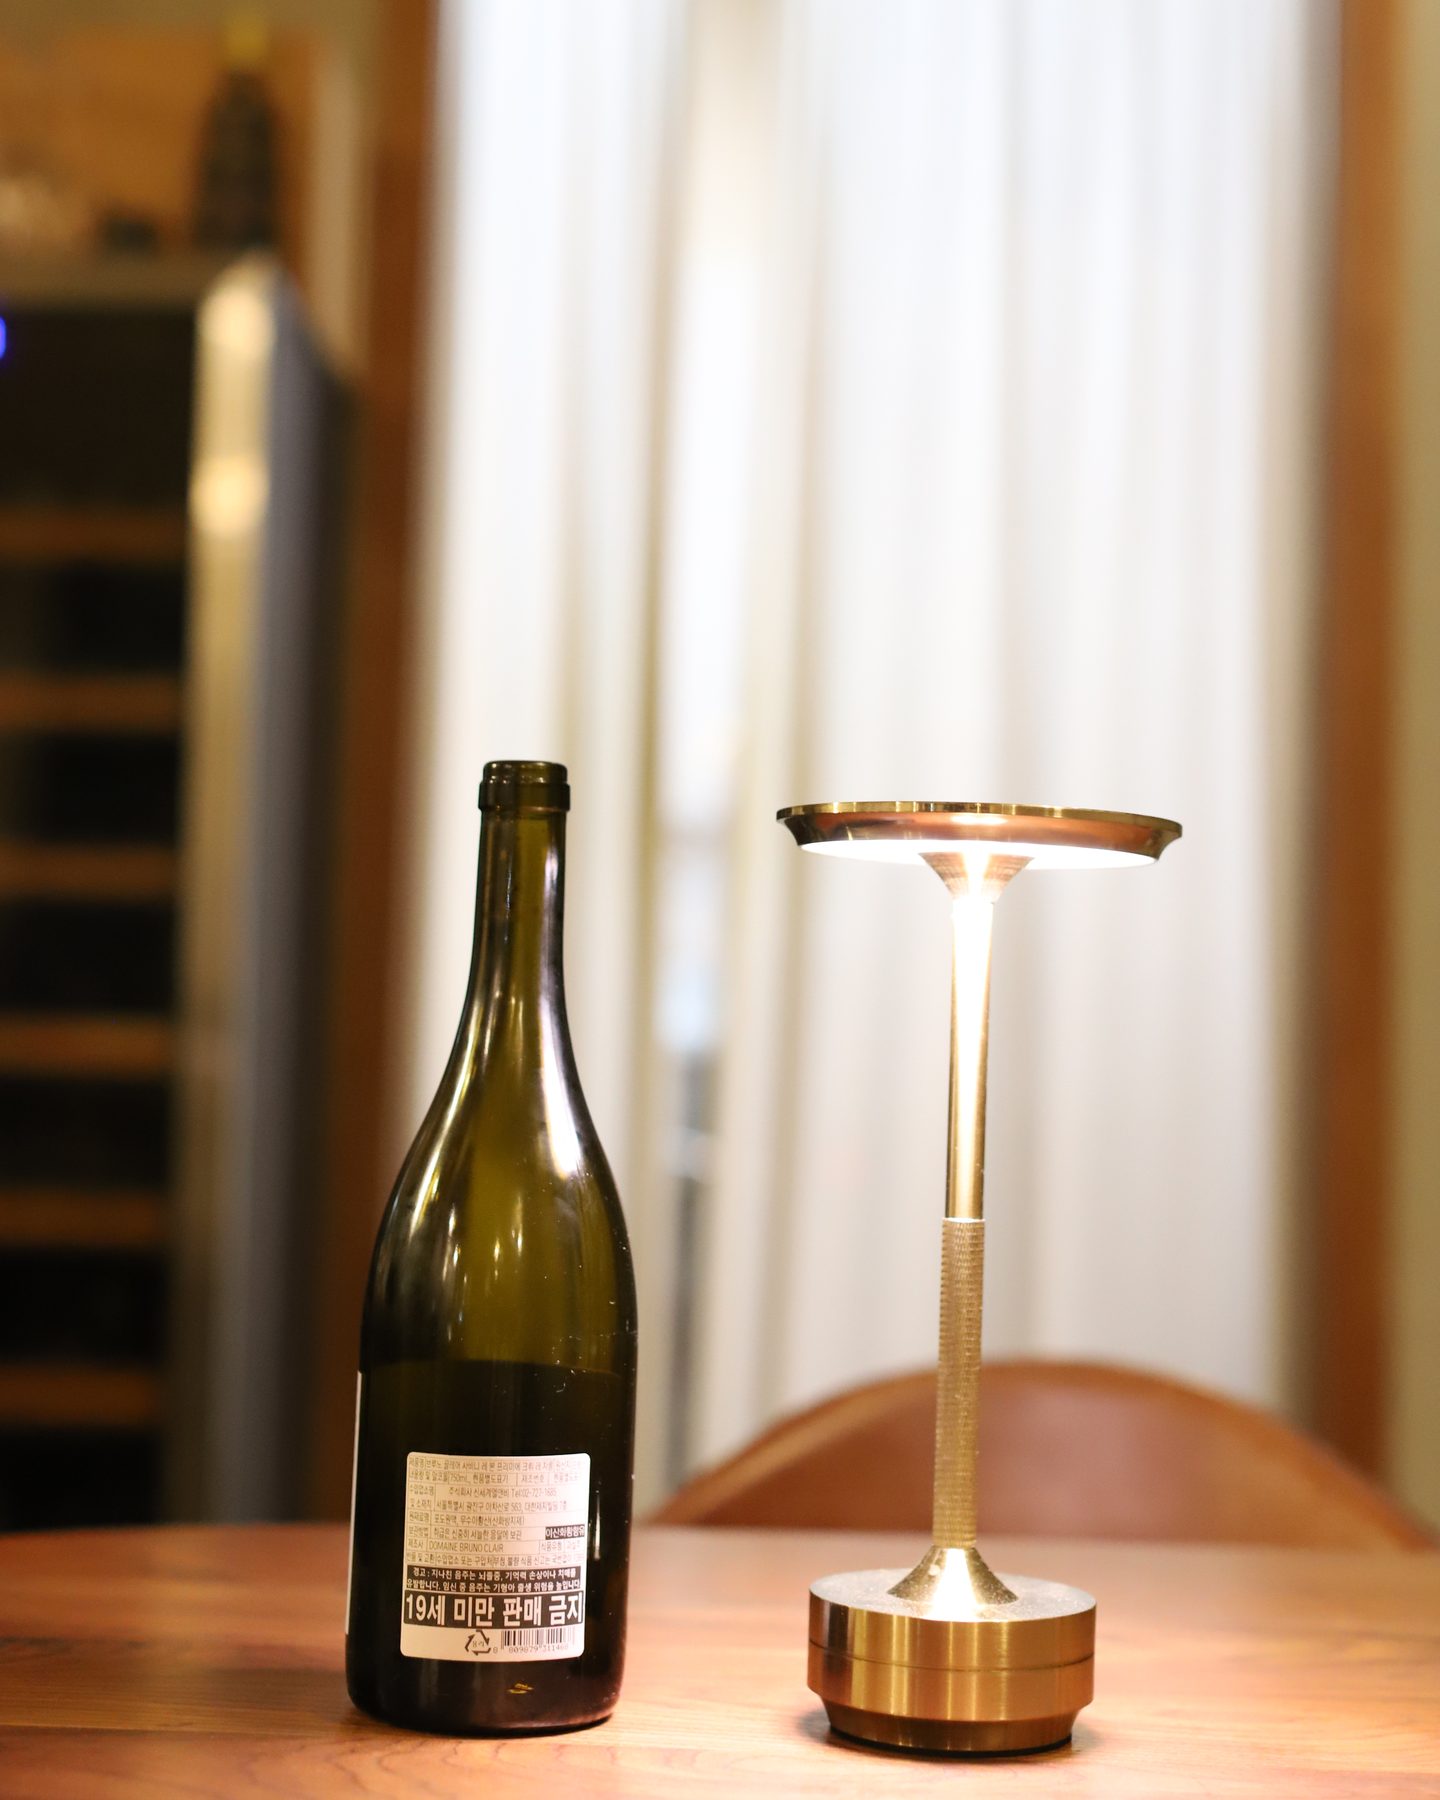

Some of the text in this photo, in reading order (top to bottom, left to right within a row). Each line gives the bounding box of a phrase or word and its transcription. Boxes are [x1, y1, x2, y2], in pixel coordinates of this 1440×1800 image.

[449, 1486, 472, 1497] 주식회사
[436, 1499, 465, 1511] 서울특별시
[466, 1500, 484, 1512] 광진구
[429, 1540, 504, 1553] DOMAINE BRUNO CLAIR
[412, 1566, 426, 1577] 경고
[431, 1568, 452, 1579] 지나친
[454, 1570, 476, 1580] 음주는
[505, 1571, 527, 1581] 기억력
[529, 1569, 556, 1580] 손상이나
[558, 1568, 577, 1579] 치매를
[442, 1581, 457, 1591] 임신
[459, 1582, 467, 1592] 중
[468, 1582, 491, 1592] 음주는
[493, 1583, 515, 1593] 기형아
[517, 1582, 532, 1593] 출생
[533, 1581, 554, 1592] 위험을
[405, 1592, 583, 1628] 19세 미만 판매 금지
